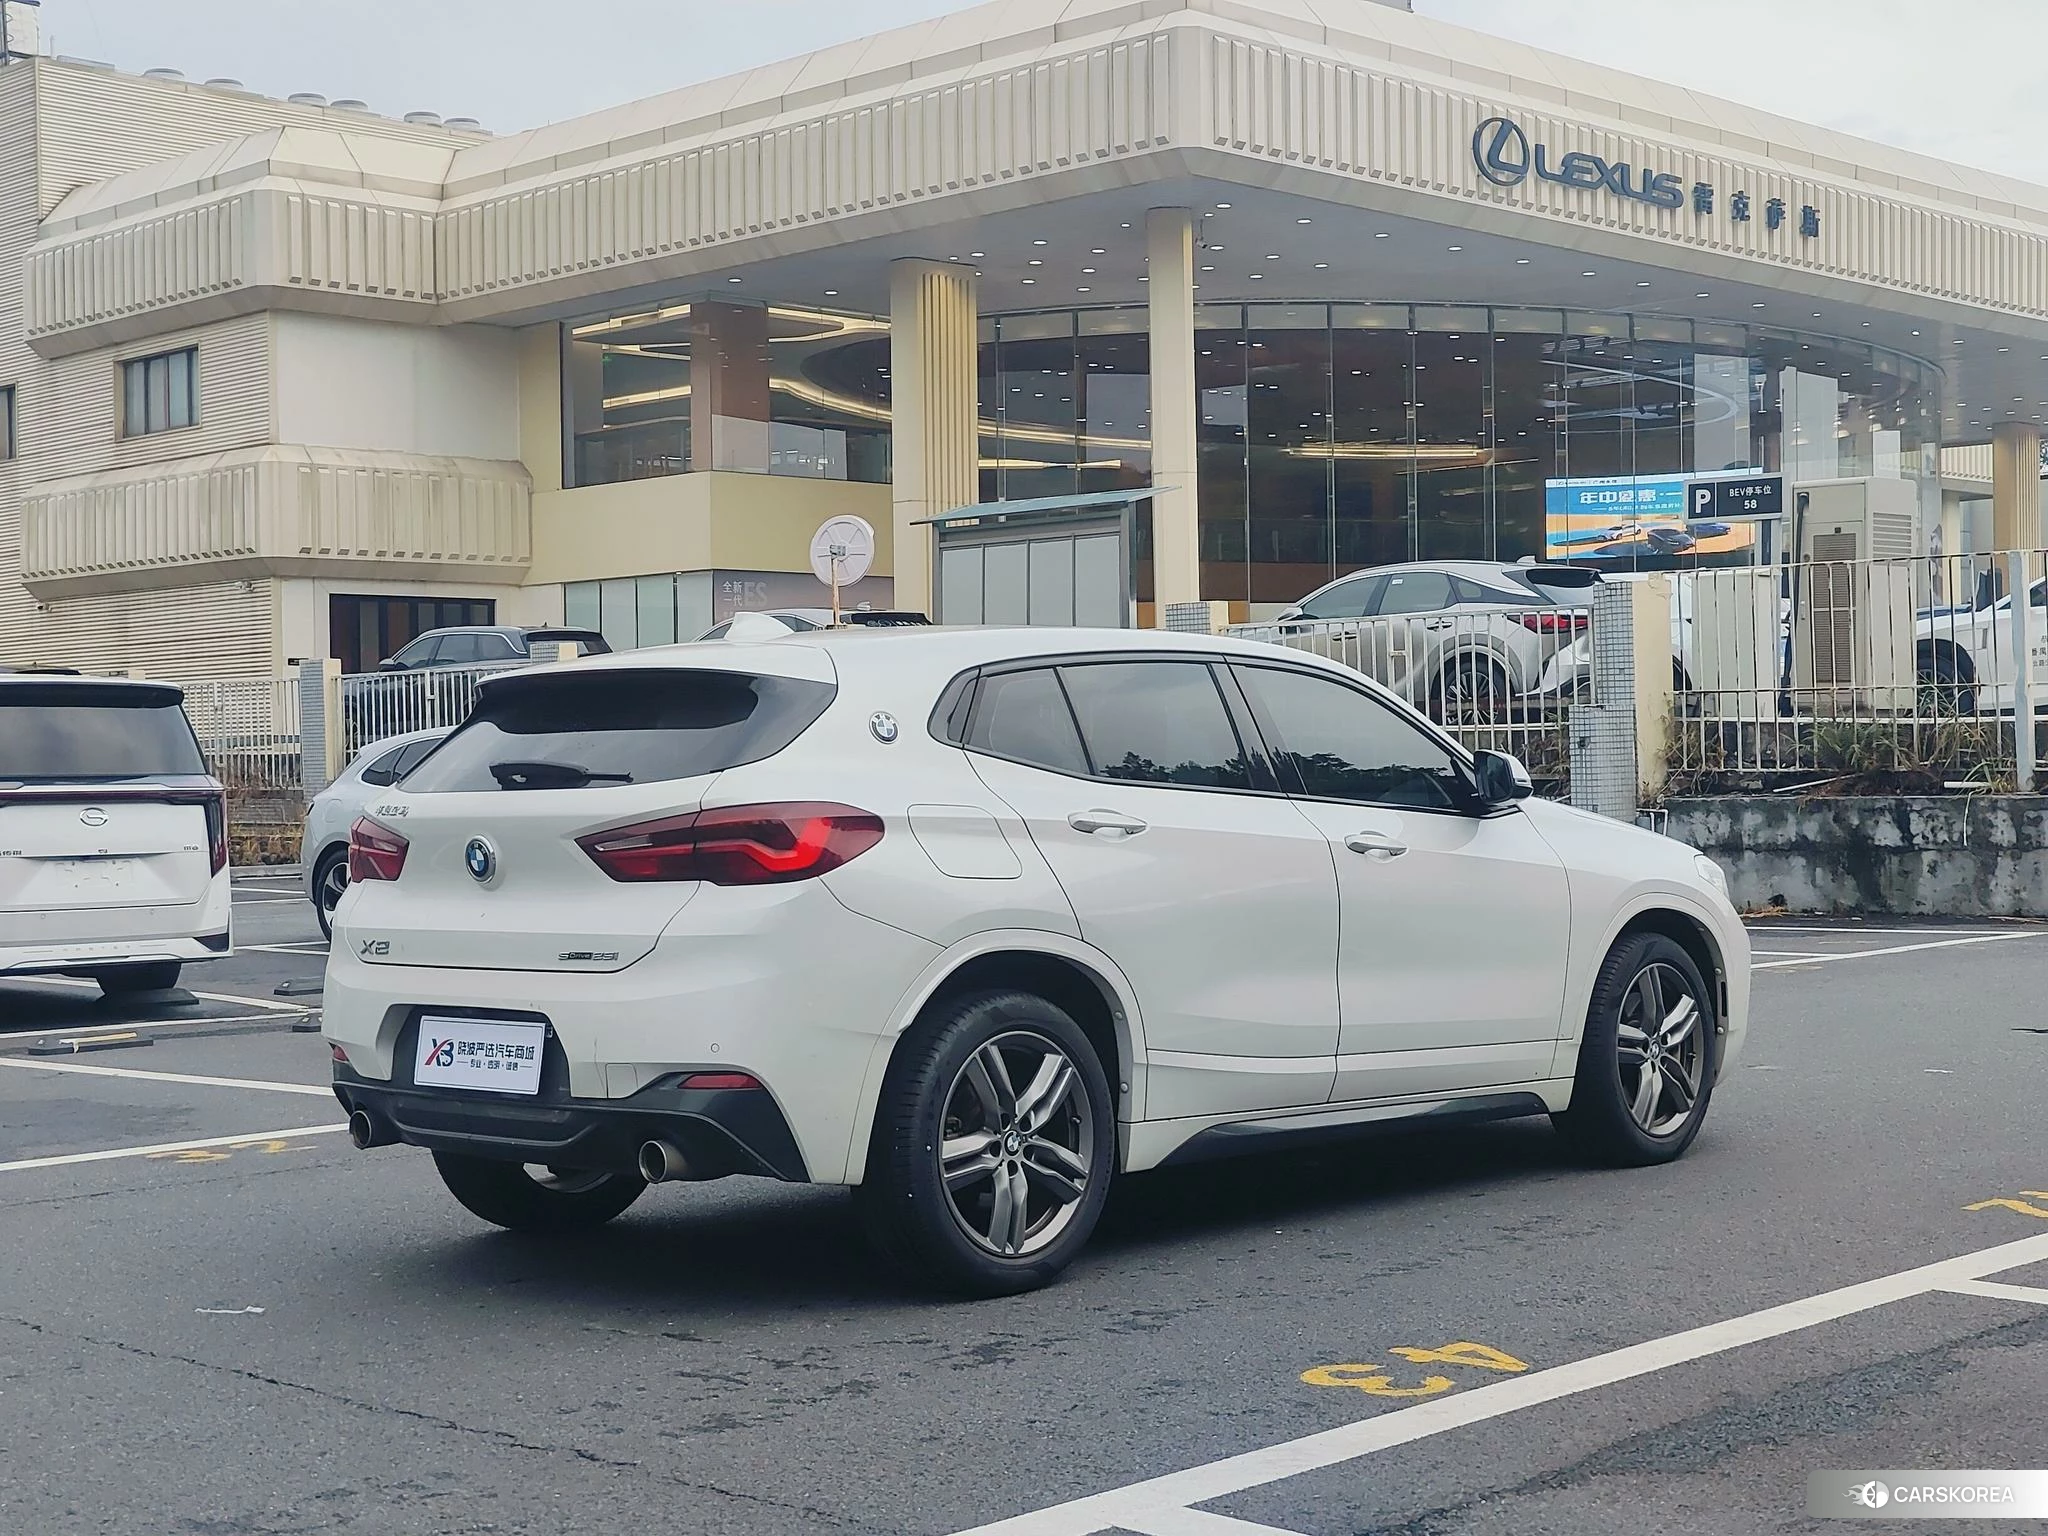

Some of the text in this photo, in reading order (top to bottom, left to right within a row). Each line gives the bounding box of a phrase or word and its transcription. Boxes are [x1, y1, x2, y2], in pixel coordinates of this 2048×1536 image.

[1534, 144, 1685, 209] LEXUS
[1695, 489, 1712, 514] P
[1743, 499, 1758, 510] 58
[722, 580, 743, 594] 全新
[743, 581, 768, 607] ES
[722, 594, 743, 607] 一代
[360, 939, 391, 955] X2
[457, 1040, 536, 1061] 晓波严选汽车商城
